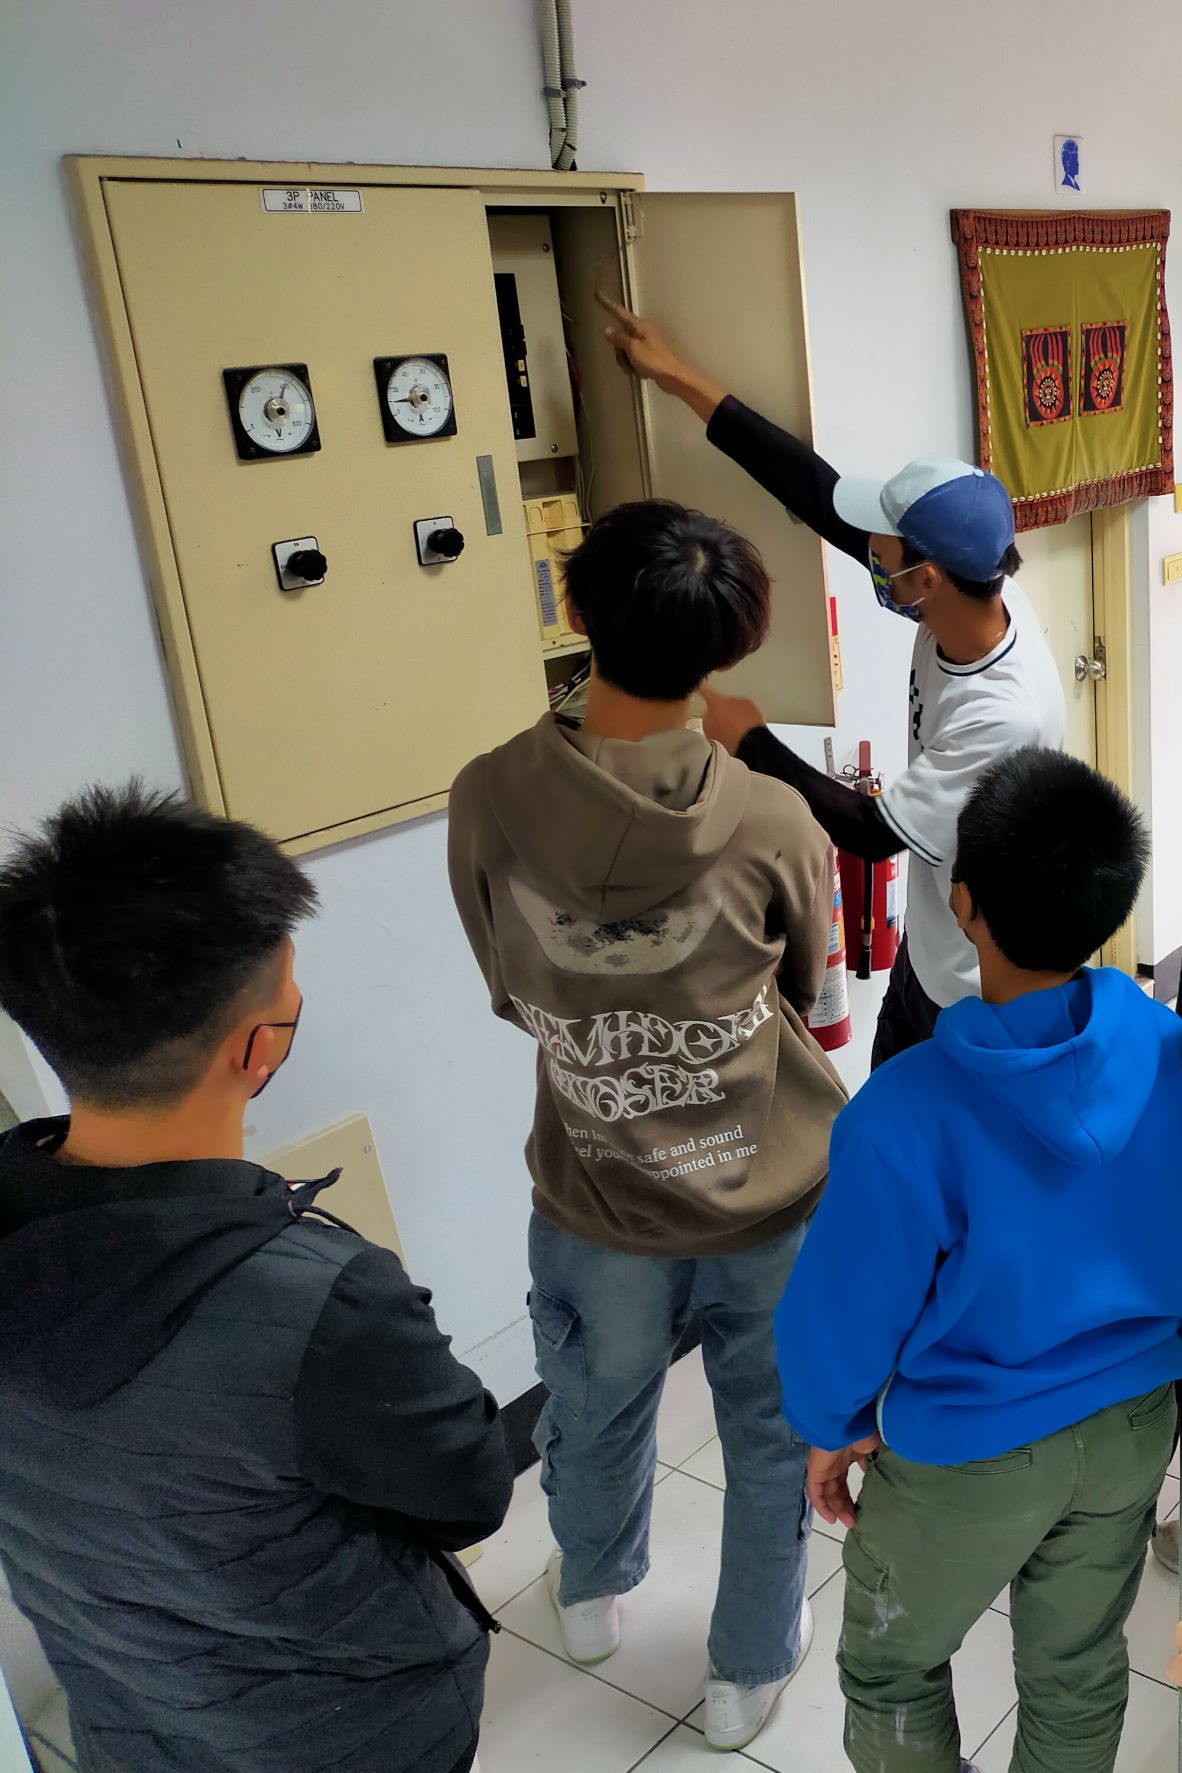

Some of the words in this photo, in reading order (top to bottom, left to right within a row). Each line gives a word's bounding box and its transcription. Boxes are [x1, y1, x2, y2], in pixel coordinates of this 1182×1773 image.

[286, 191, 300, 202] 3P
[307, 191, 339, 202] PANEL
[563, 1122, 588, 1139] hen
[637, 1147, 668, 1164] safe
[671, 1138, 697, 1157] and
[699, 1125, 745, 1149] sound
[718, 1150, 733, 1164] in
[735, 1143, 758, 1159] me
